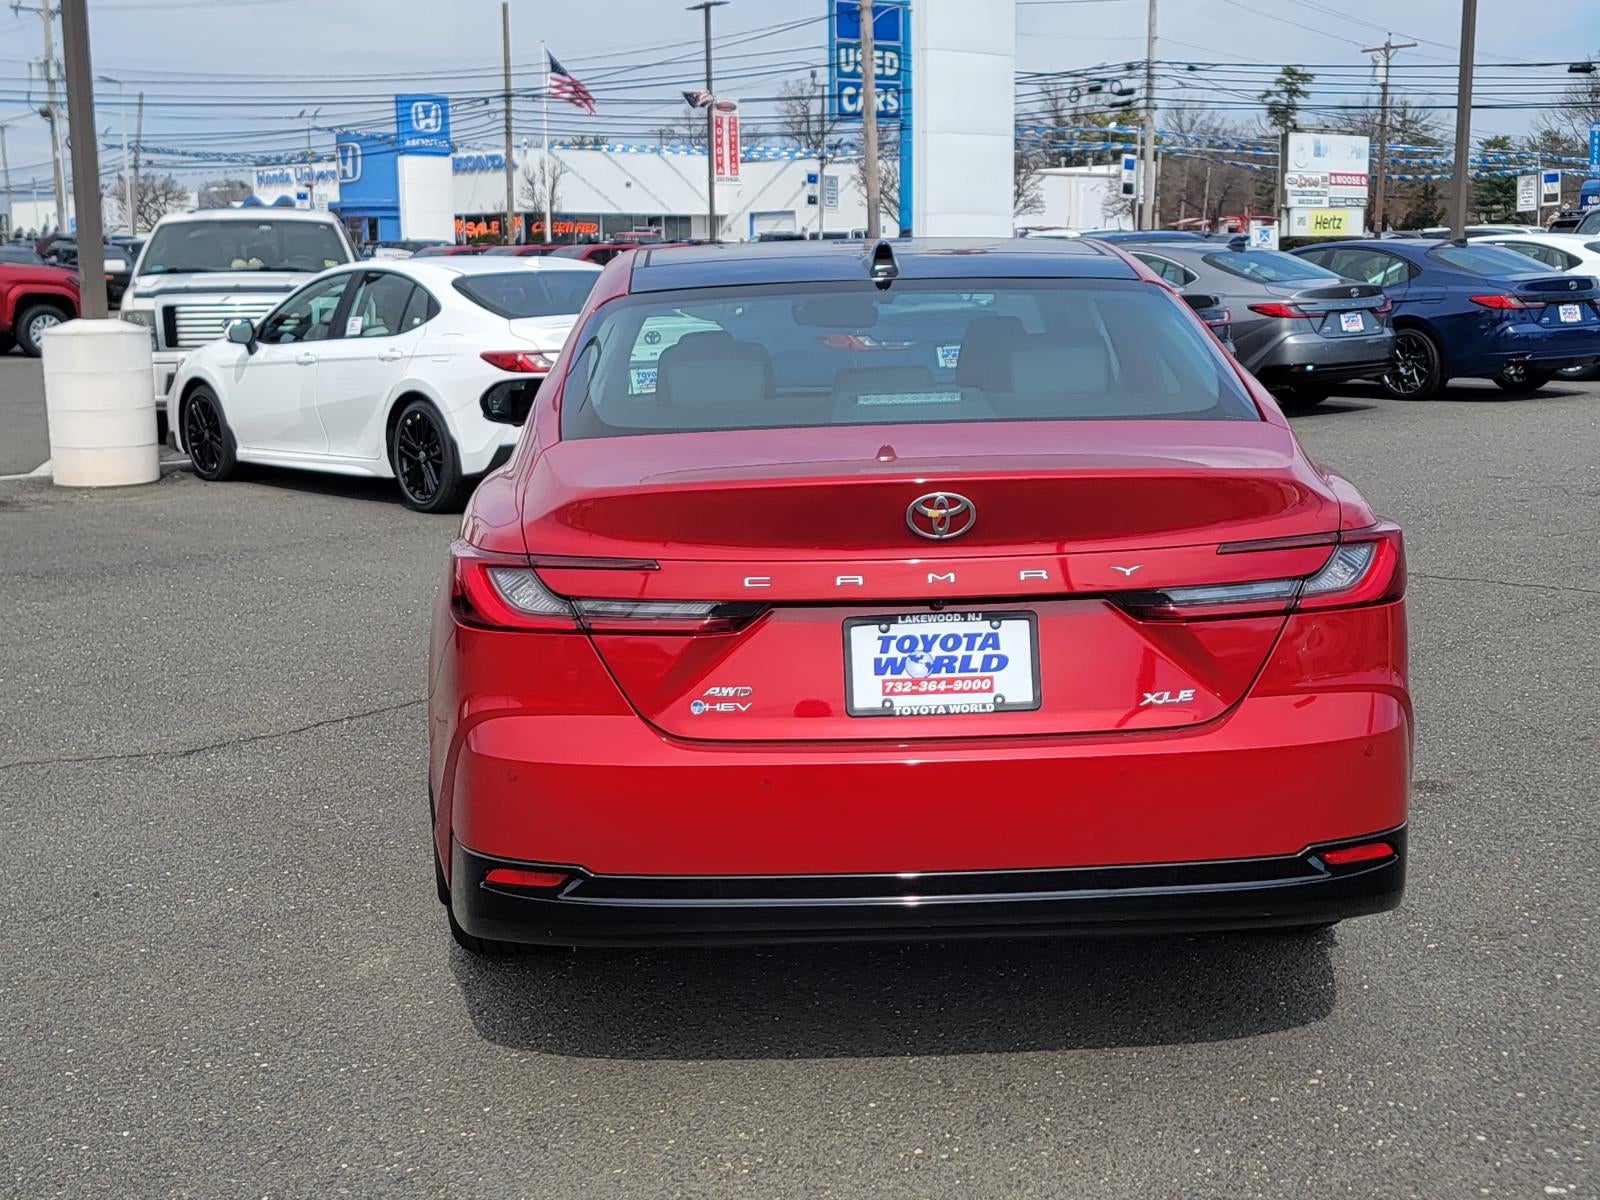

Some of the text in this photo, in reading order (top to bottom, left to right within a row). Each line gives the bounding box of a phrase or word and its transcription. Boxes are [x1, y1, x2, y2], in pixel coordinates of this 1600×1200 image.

[716, 116, 724, 176] TOYOTA
[465, 221, 499, 236] SALE
[1314, 215, 1342, 230] Hertz
[636, 371, 657, 379] TOYO
[743, 564, 1143, 588] CAMRY
[967, 612, 982, 622] NJ
[877, 632, 1001, 655] TOYOTA
[702, 686, 753, 697] AWD
[884, 678, 992, 693] 732-364-9000
[1138, 688, 1196, 706] XLE
[704, 702, 753, 712] HEV
[893, 703, 995, 716] TOYOTA WORLD
